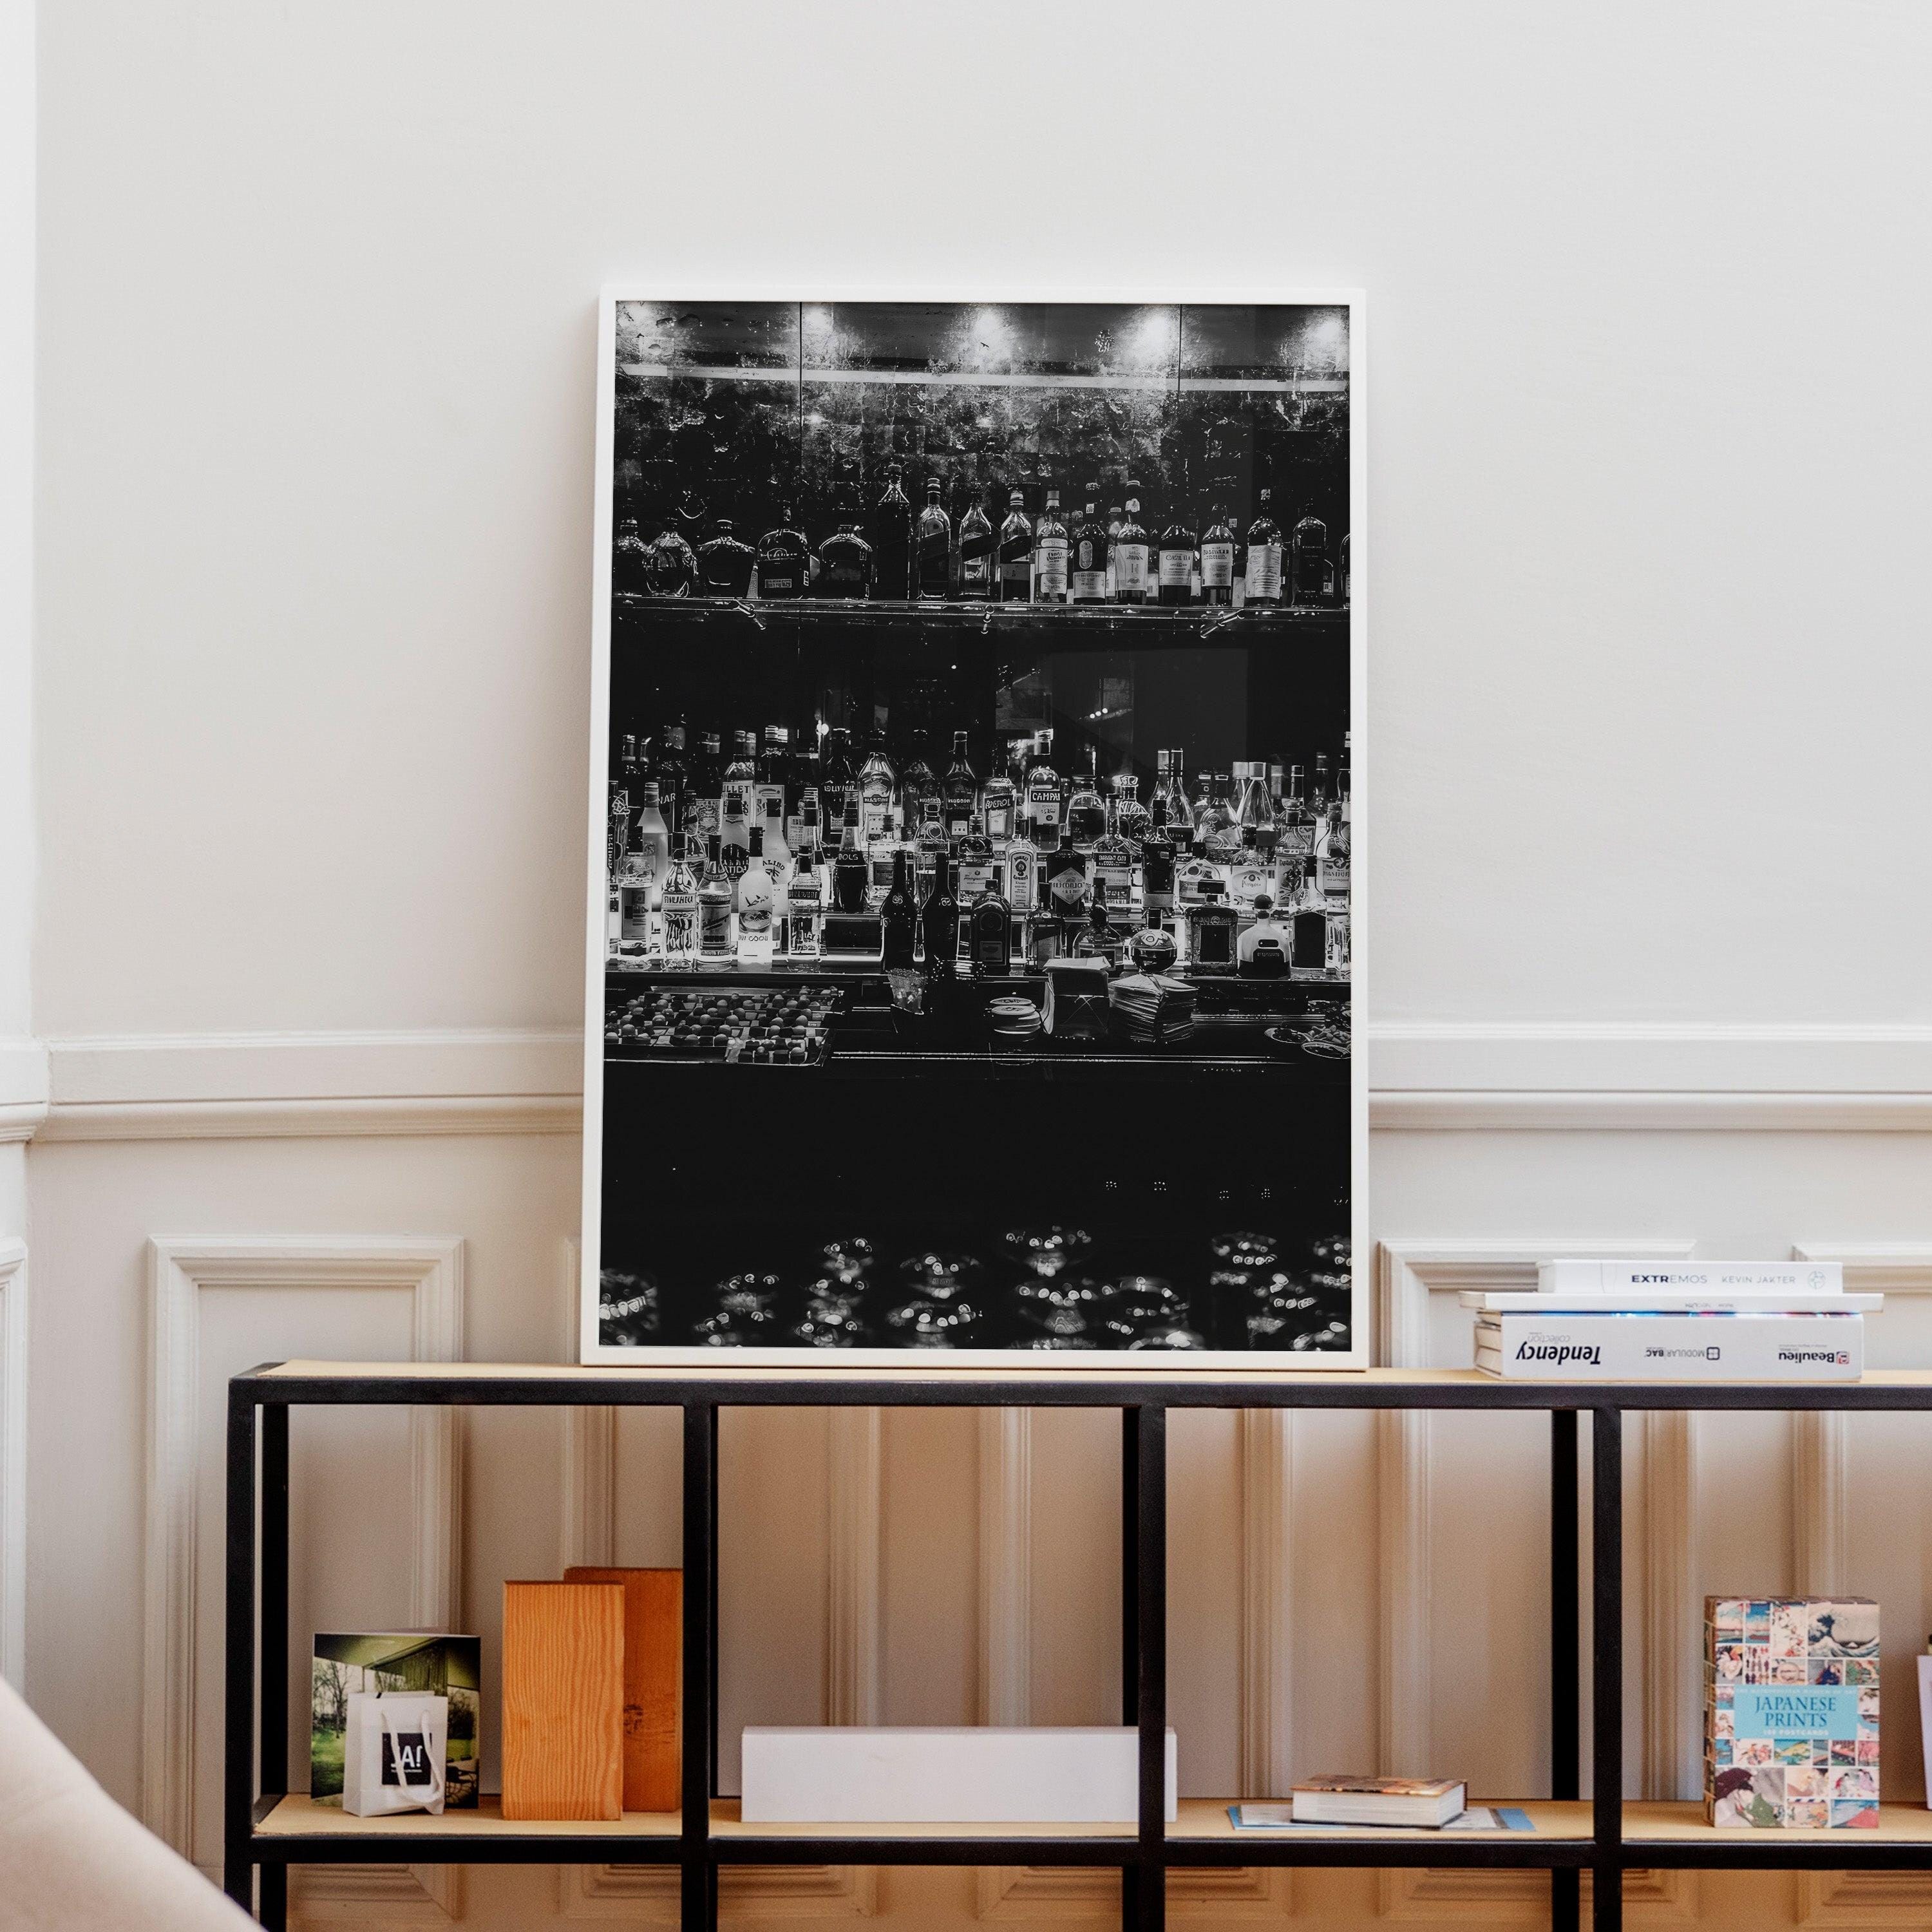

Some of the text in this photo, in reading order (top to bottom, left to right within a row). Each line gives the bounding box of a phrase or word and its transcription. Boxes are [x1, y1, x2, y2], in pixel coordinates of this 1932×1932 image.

[1631, 1274, 1708, 1284] EXTREMOS
[1721, 1275, 1752, 1283] KEVIN
[1515, 1340, 1601, 1366] Tendency
[1645, 1349, 1705, 1358] MODULAR BAC
[1778, 1351, 1835, 1363] Beaulieu
[1754, 1696, 1837, 1714] JAPANESE
[1765, 1712, 1828, 1727] PRINTS
